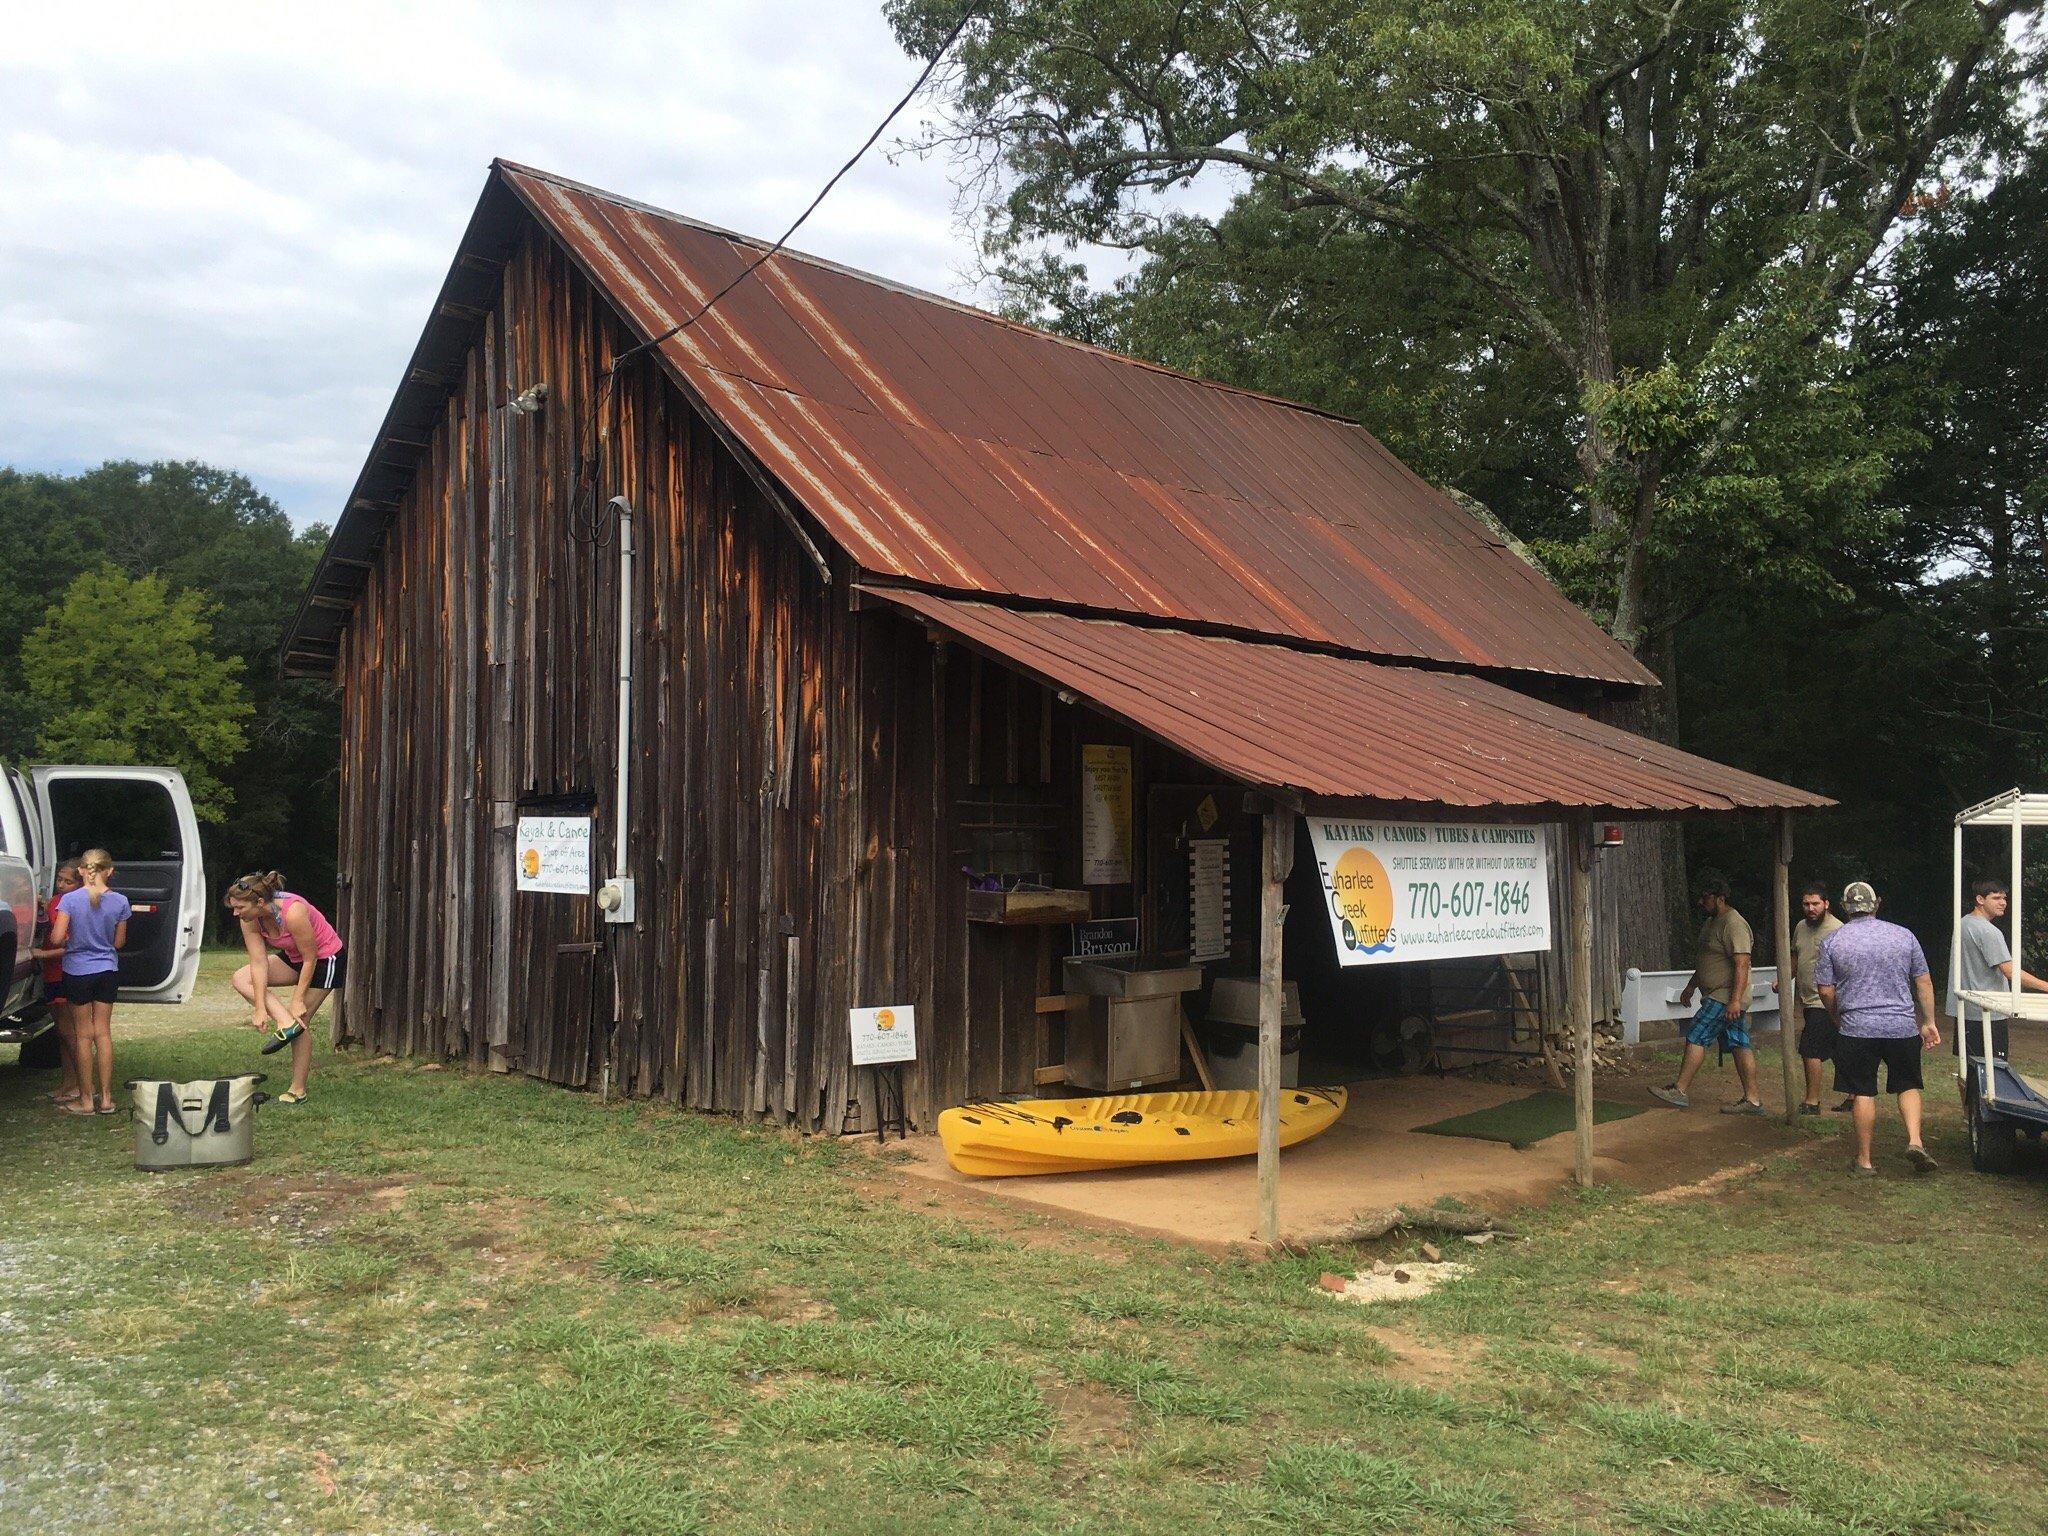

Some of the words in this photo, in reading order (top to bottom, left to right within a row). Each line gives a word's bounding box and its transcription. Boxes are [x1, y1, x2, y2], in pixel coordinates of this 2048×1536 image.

[520, 821, 544, 842] Kayak
[548, 821, 555, 838] &
[559, 821, 589, 839] Canoe
[1323, 824, 1374, 842] KAYAKS
[1383, 826, 1427, 842] CANOES
[1434, 827, 1469, 843] TUBES
[1472, 828, 1480, 843] &
[1482, 828, 1536, 844] CAMPSITES
[1319, 861, 1374, 890] Euharlee
[1392, 857, 1418, 870] SHUTTLE
[1419, 857, 1447, 870] SERVICES
[1449, 857, 1464, 870] WITH
[1466, 857, 1475, 870] OR
[1476, 857, 1502, 870] WITHOUT
[1503, 857, 1515, 870] OUR
[1331, 891, 1368, 920] Creek
[1408, 880, 1530, 919] 770-607-1846
[1080, 928, 1113, 941] Brandon
[1342, 919, 1397, 951] Outfitters
[1401, 921, 1544, 945] www.euharleecreekoutfitters.com
